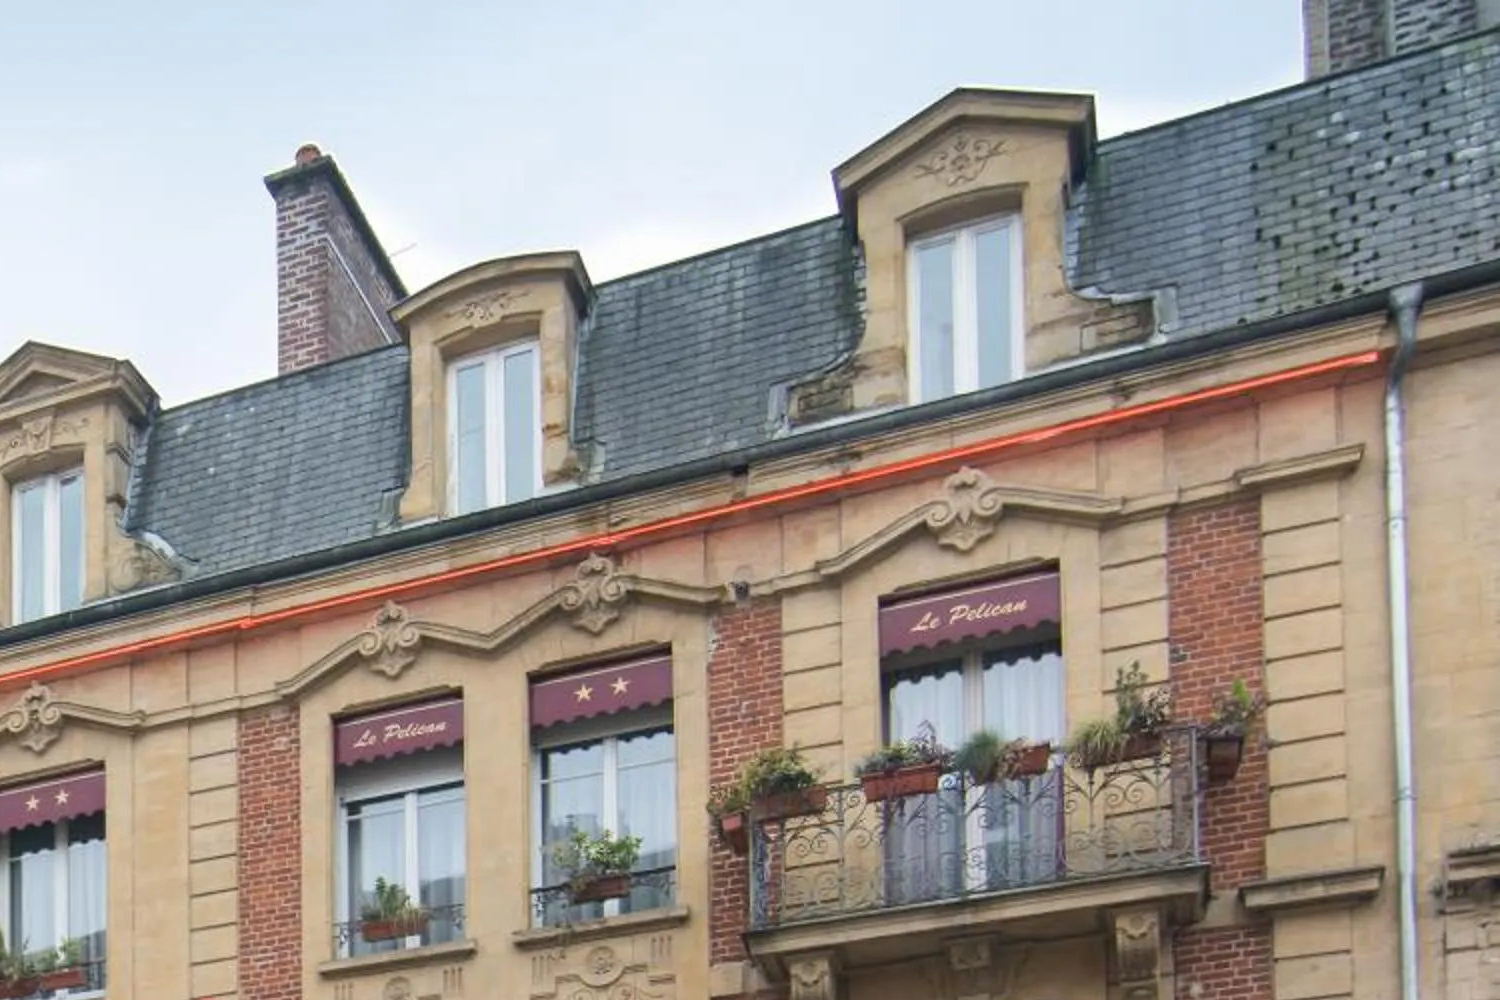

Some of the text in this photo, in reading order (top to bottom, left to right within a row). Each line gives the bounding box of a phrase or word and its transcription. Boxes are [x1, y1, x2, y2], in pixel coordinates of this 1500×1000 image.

[910, 600, 1027, 632] Le Pelican
[353, 722, 447, 748] Le Pelican
